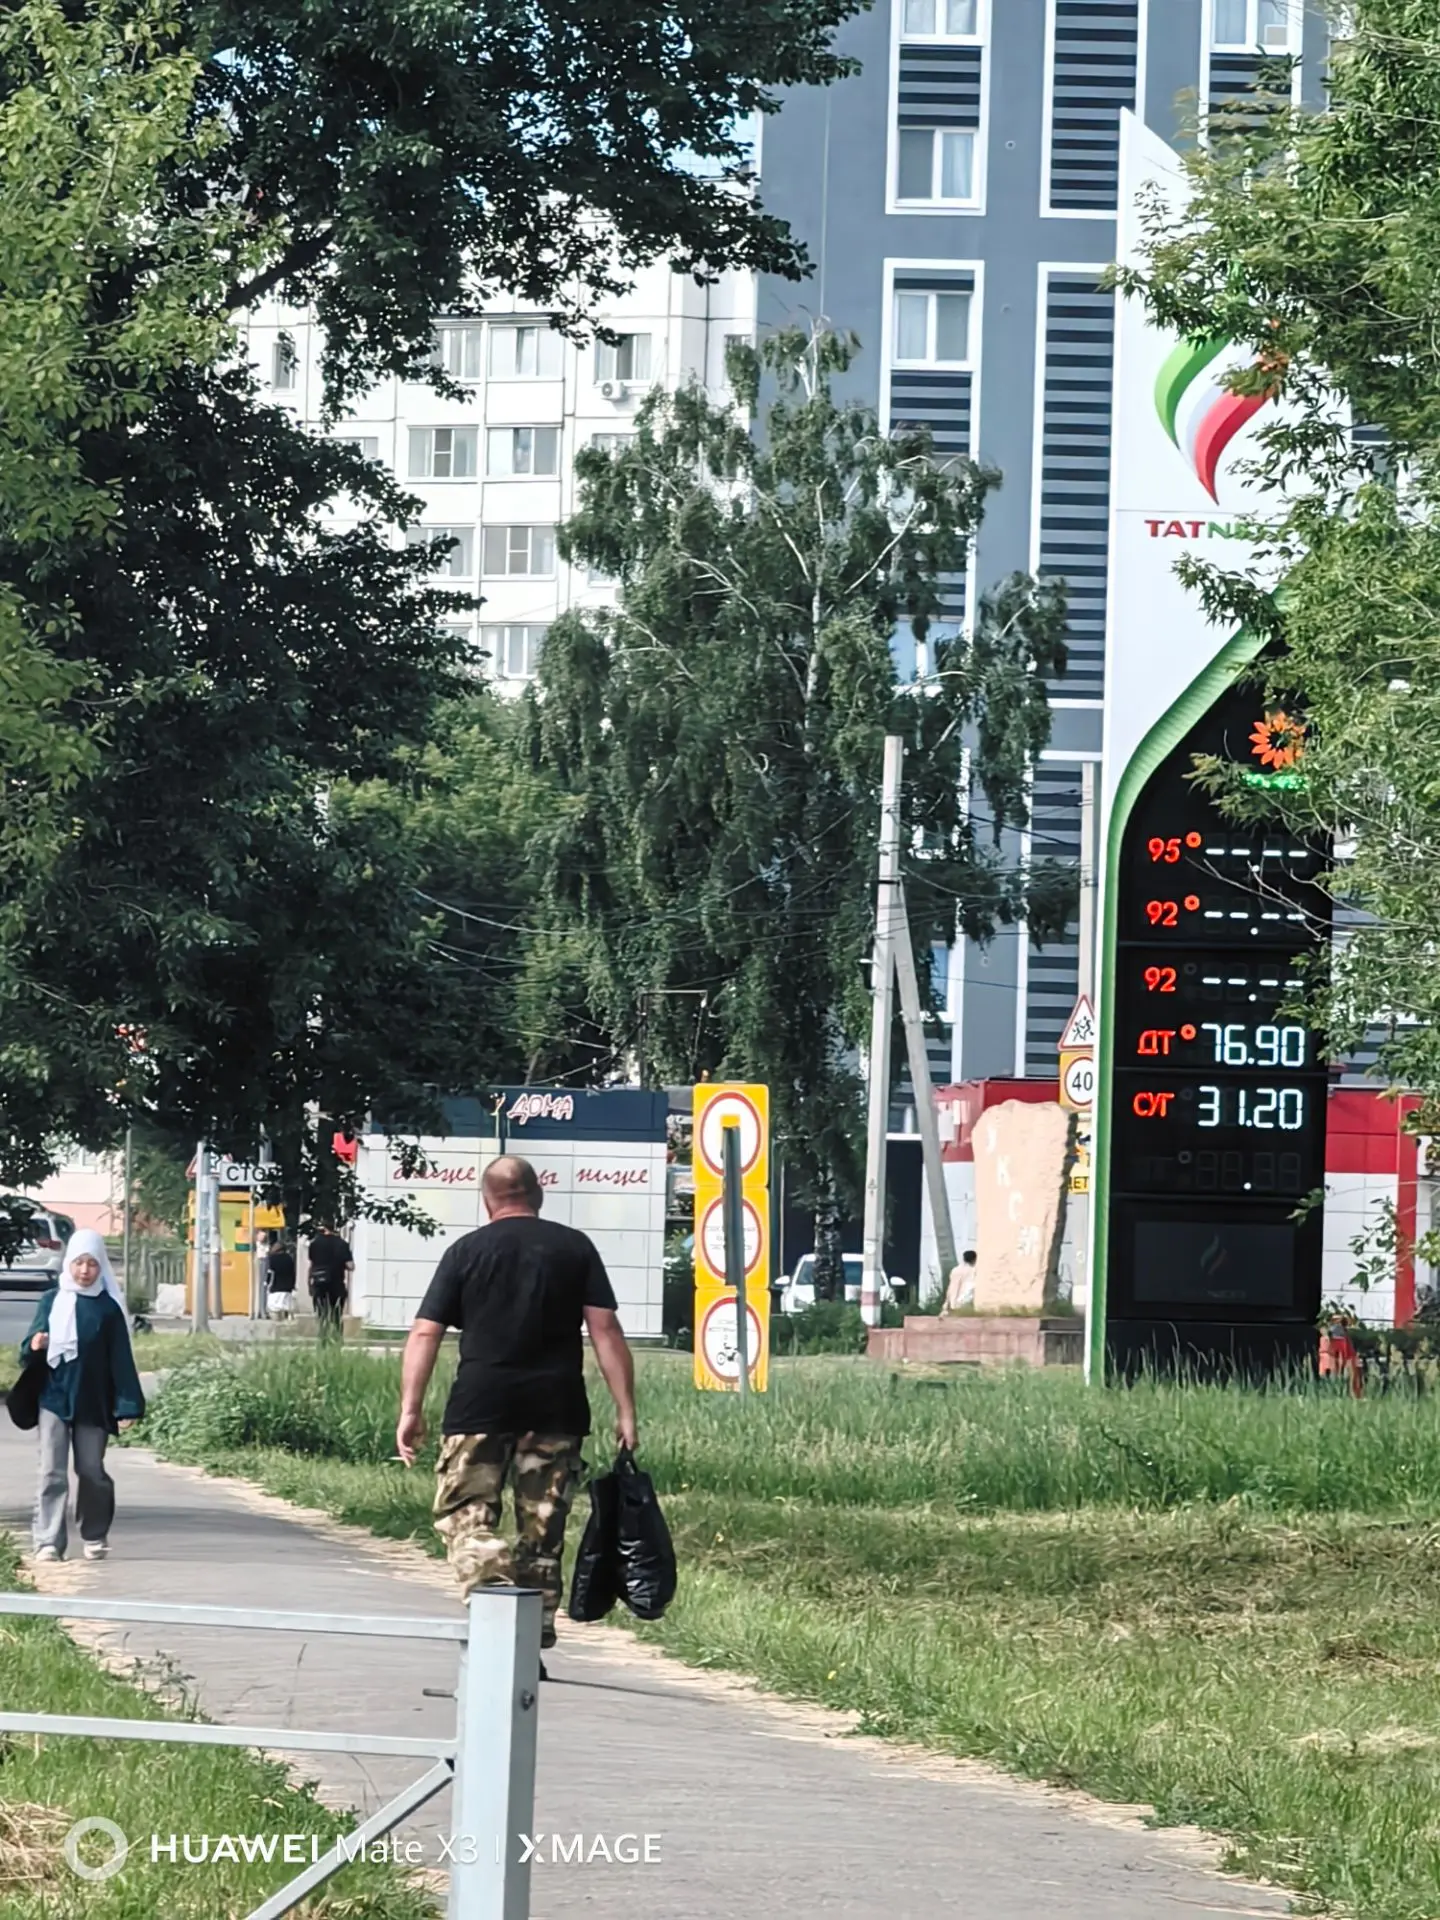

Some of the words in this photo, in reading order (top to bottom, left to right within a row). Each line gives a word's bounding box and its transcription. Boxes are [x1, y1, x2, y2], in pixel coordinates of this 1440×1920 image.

[1144, 519, 1284, 541] TATN
[1148, 837, 1182, 863] 95
[1146, 900, 1178, 926] 92
[1144, 966, 1177, 992] 92
[1137, 1030, 1176, 1055] ДТ
[1201, 1023, 1305, 1067] 76.90
[1072, 1071, 1094, 1092] 40
[506, 1093, 575, 1125] ДОМА
[1198, 1085, 1303, 1130] 31.20
[226, 1165, 281, 1182] СТО
